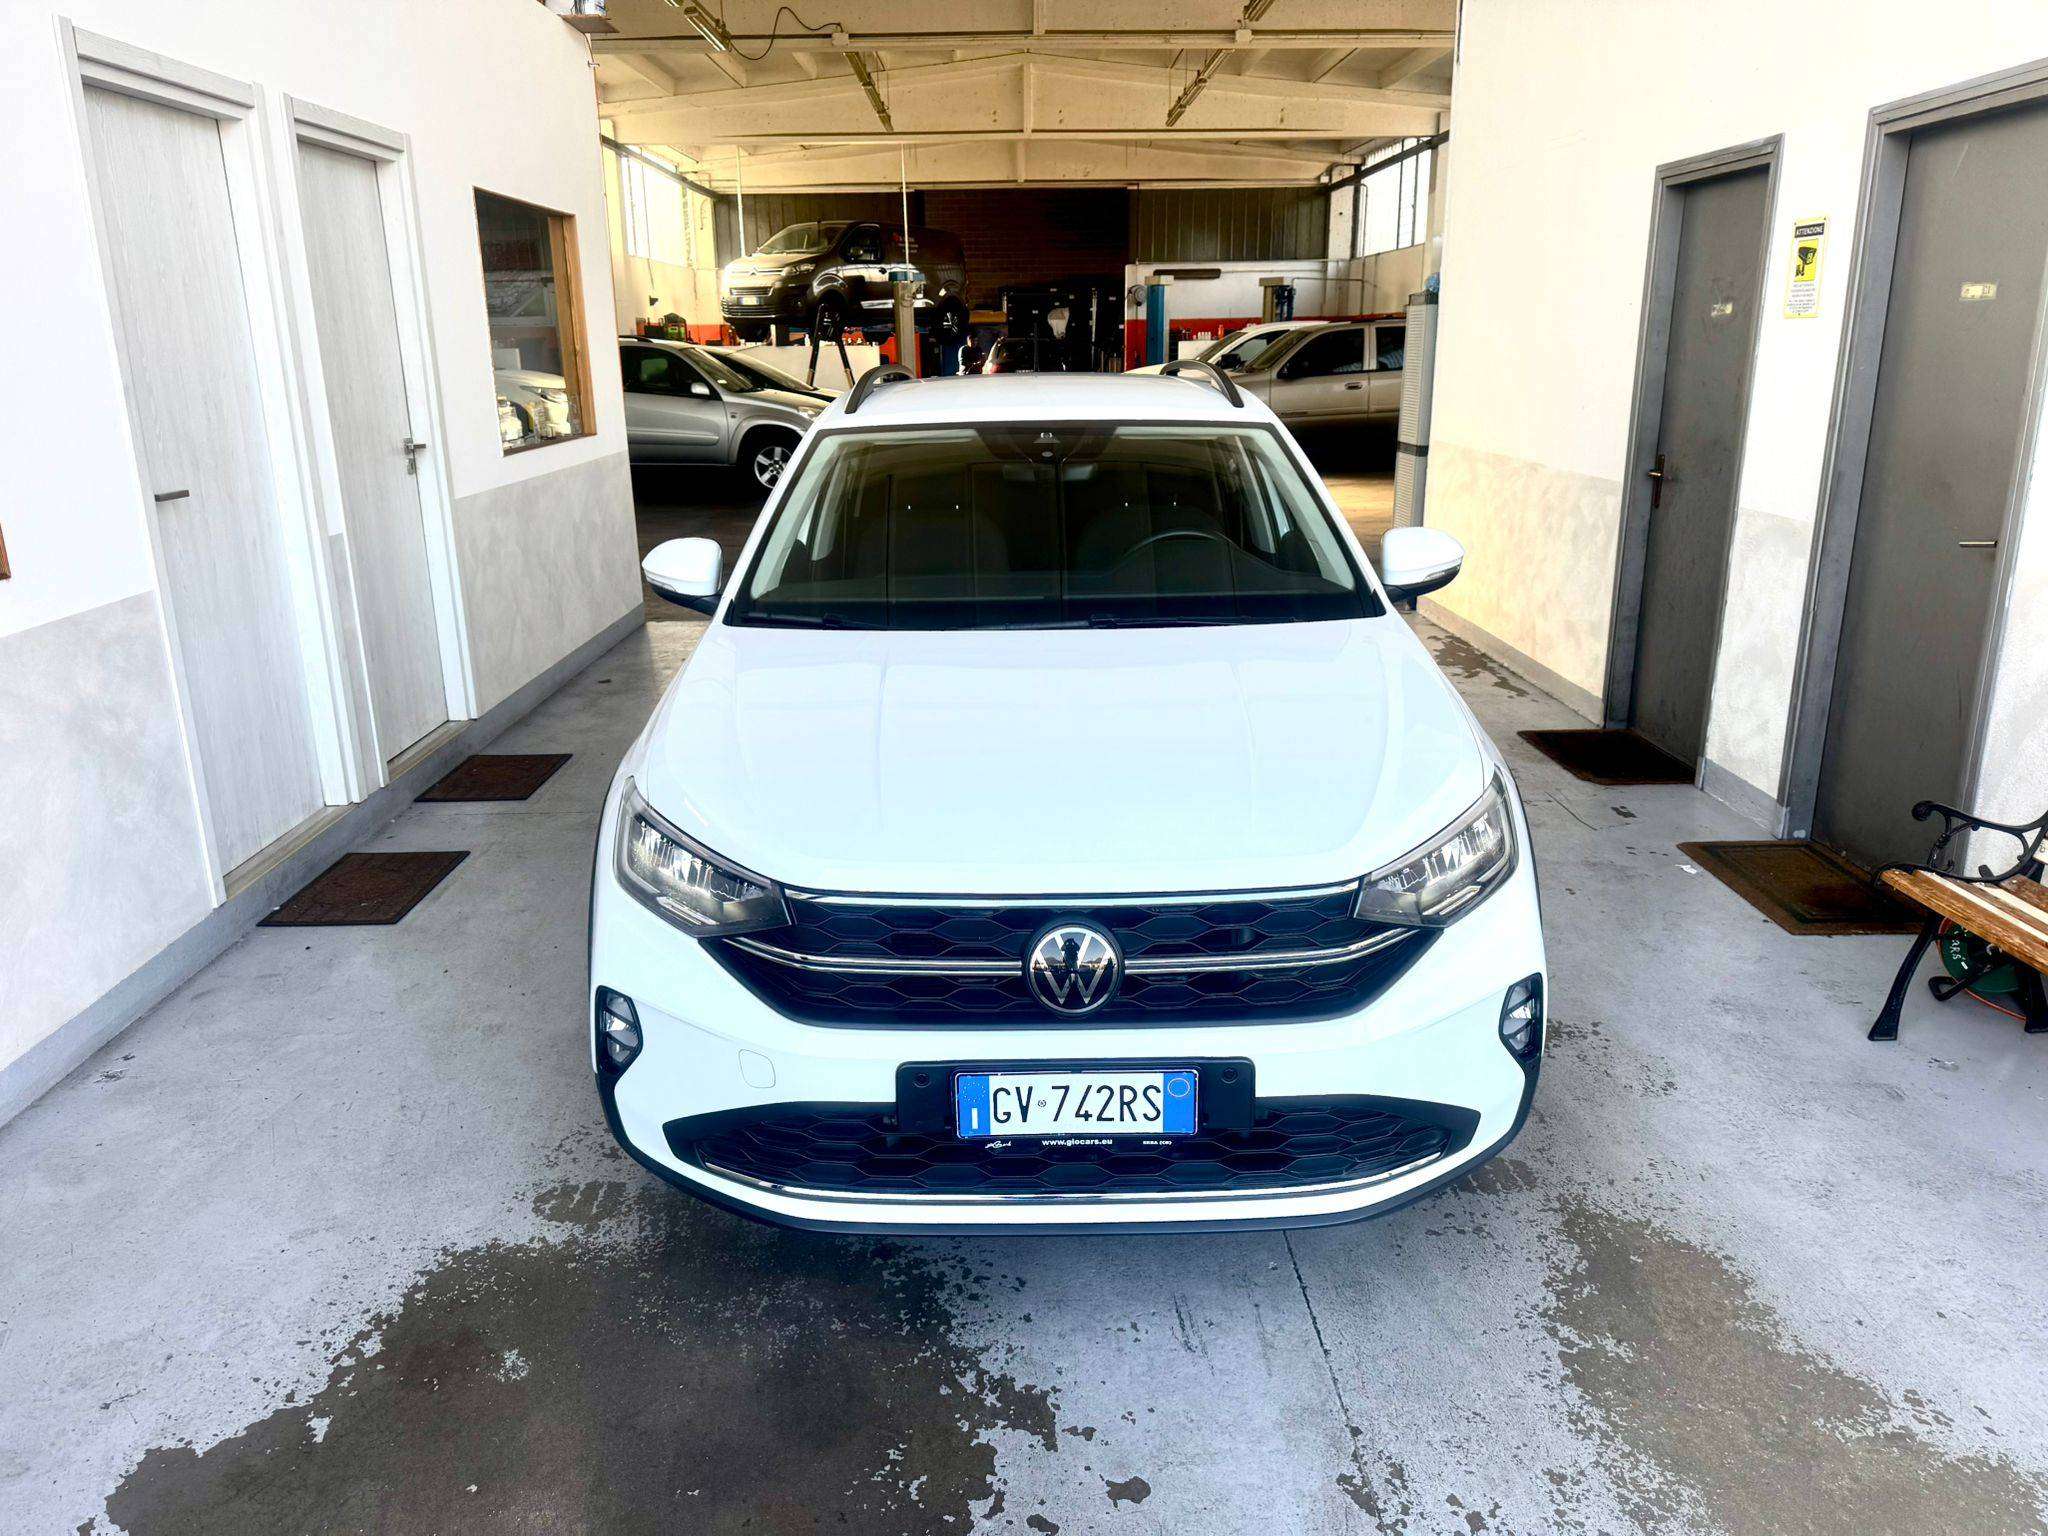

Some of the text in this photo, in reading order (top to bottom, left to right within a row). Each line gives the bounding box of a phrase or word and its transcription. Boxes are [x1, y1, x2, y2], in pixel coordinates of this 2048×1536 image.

[993, 1085, 1162, 1123] GV 742RS
[1042, 1138, 1113, 1147] www.giocars.eu
